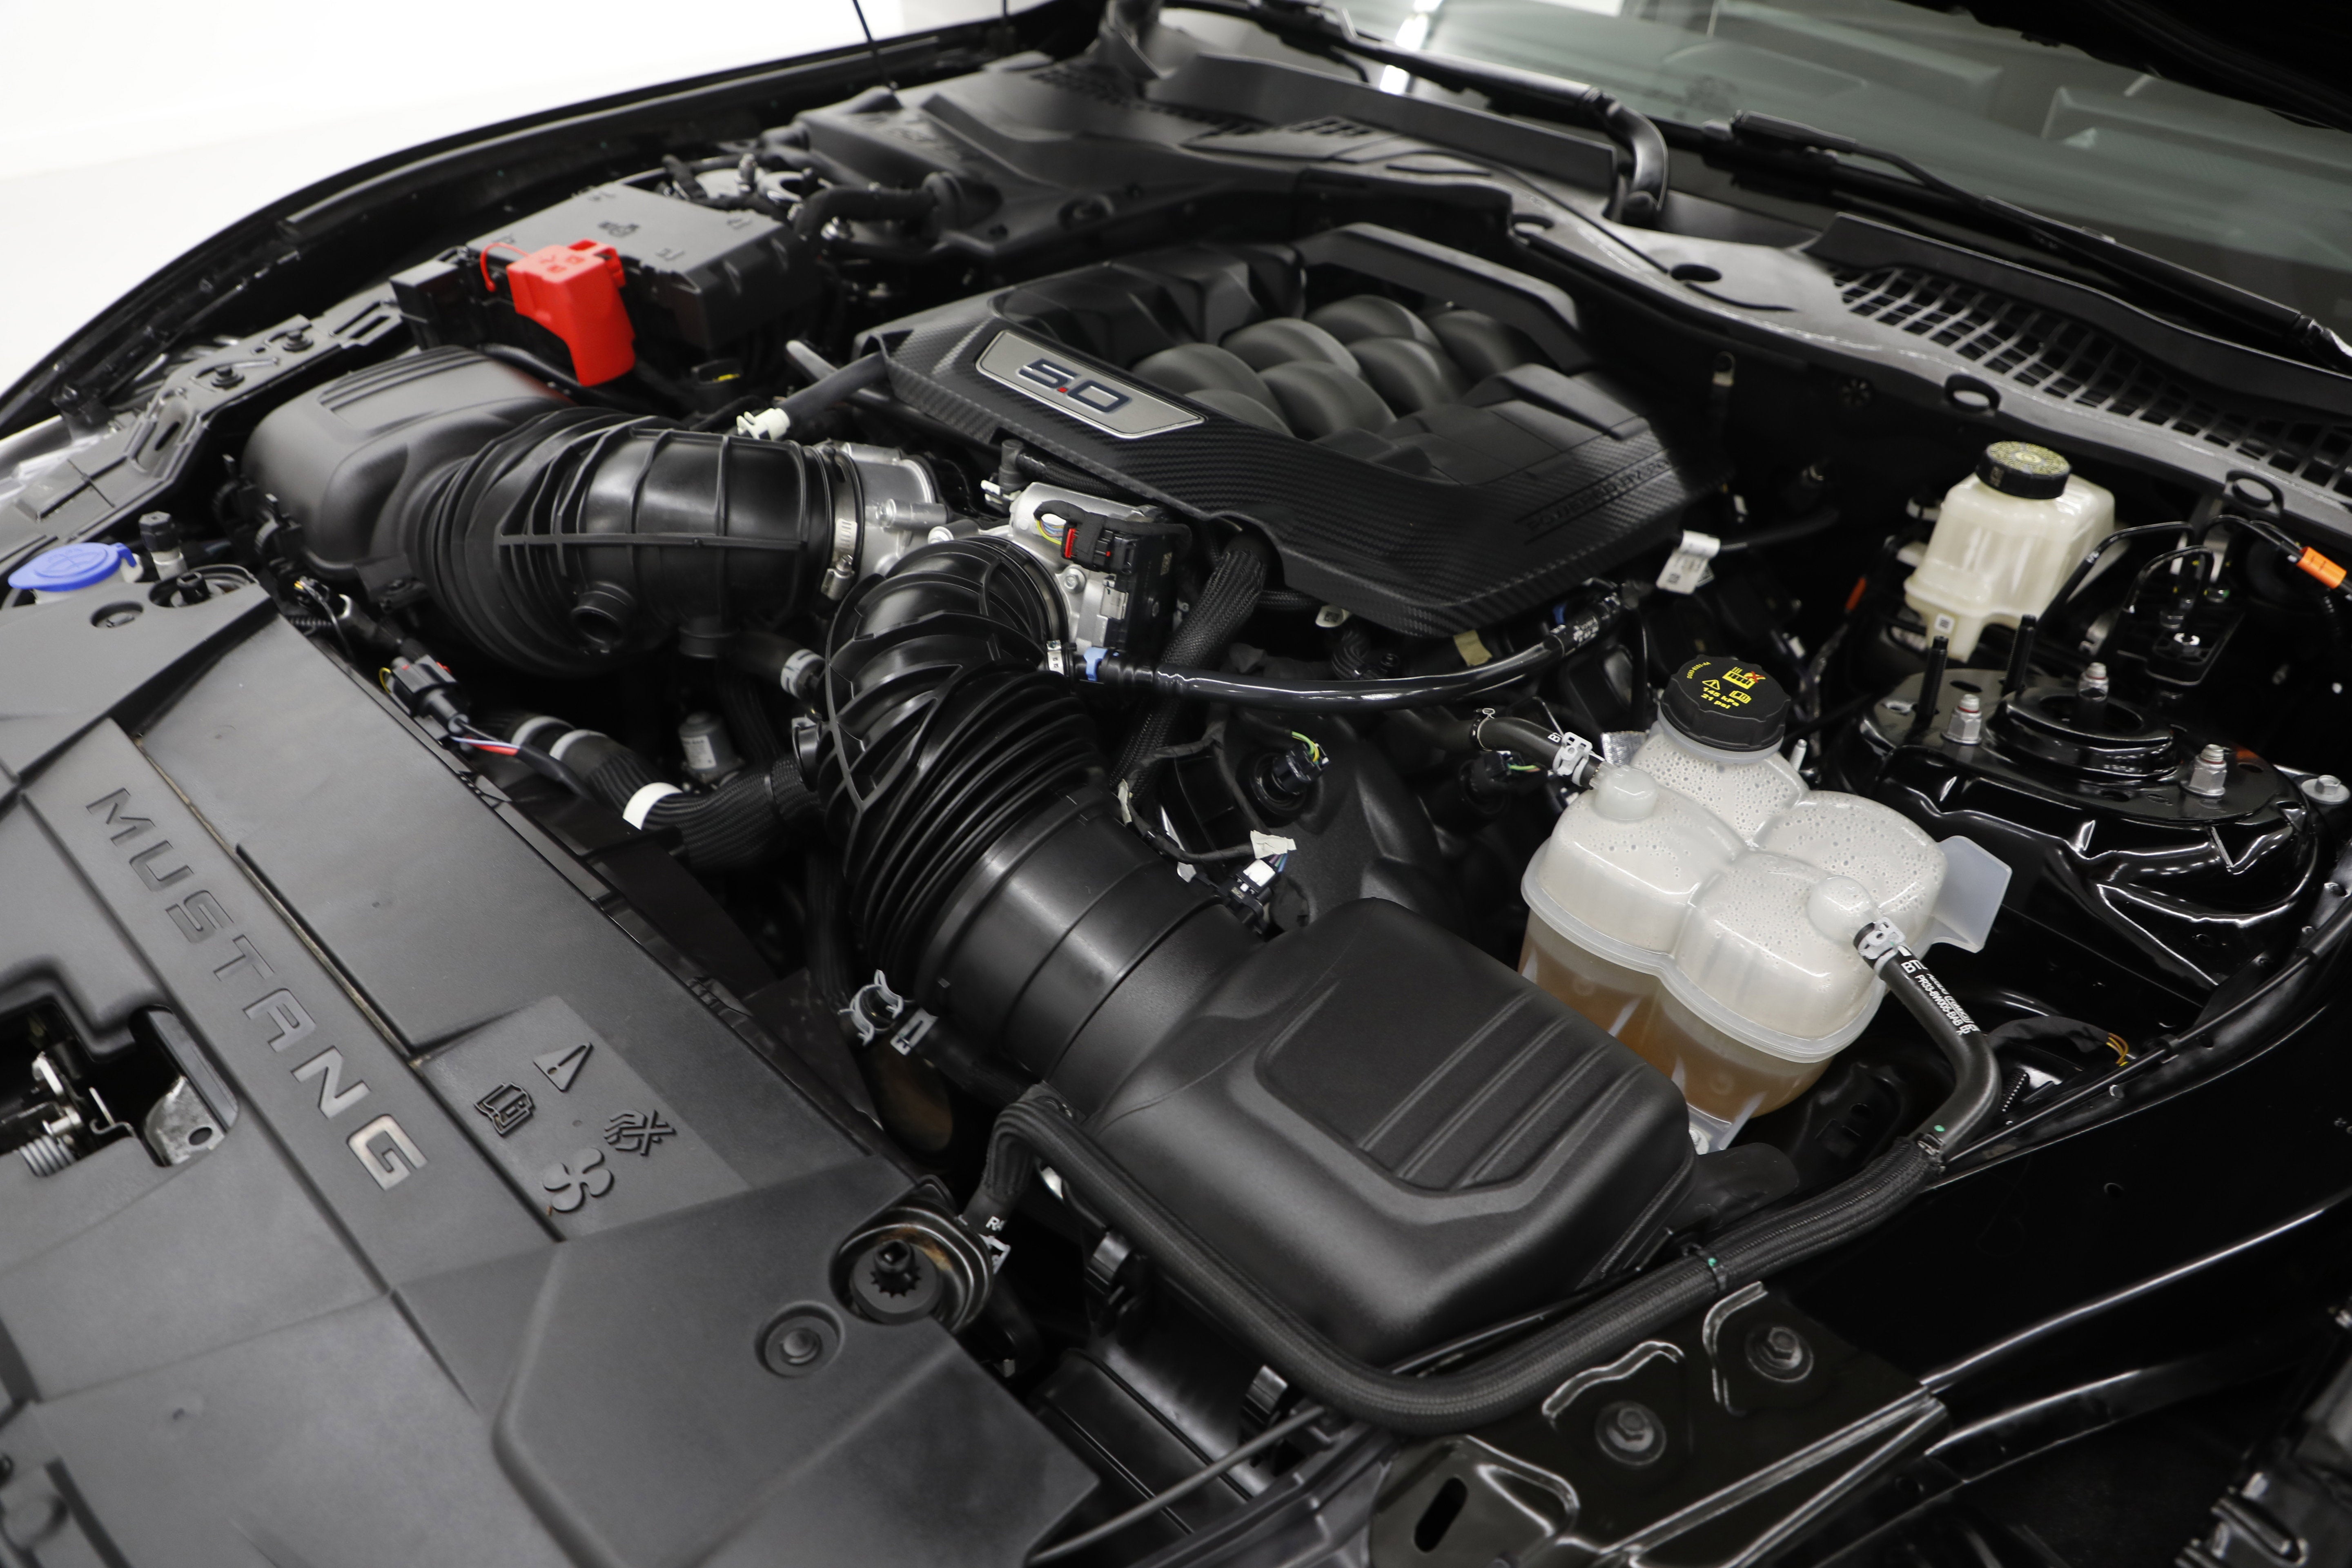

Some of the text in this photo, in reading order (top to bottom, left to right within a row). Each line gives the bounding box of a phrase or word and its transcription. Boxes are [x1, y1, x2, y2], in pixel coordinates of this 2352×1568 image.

[1016, 358, 1132, 414] 5.0
[1703, 687, 1740, 706] 145 kPa
[1714, 700, 1731, 709] psi
[85, 787, 428, 1191] MUSTANG
